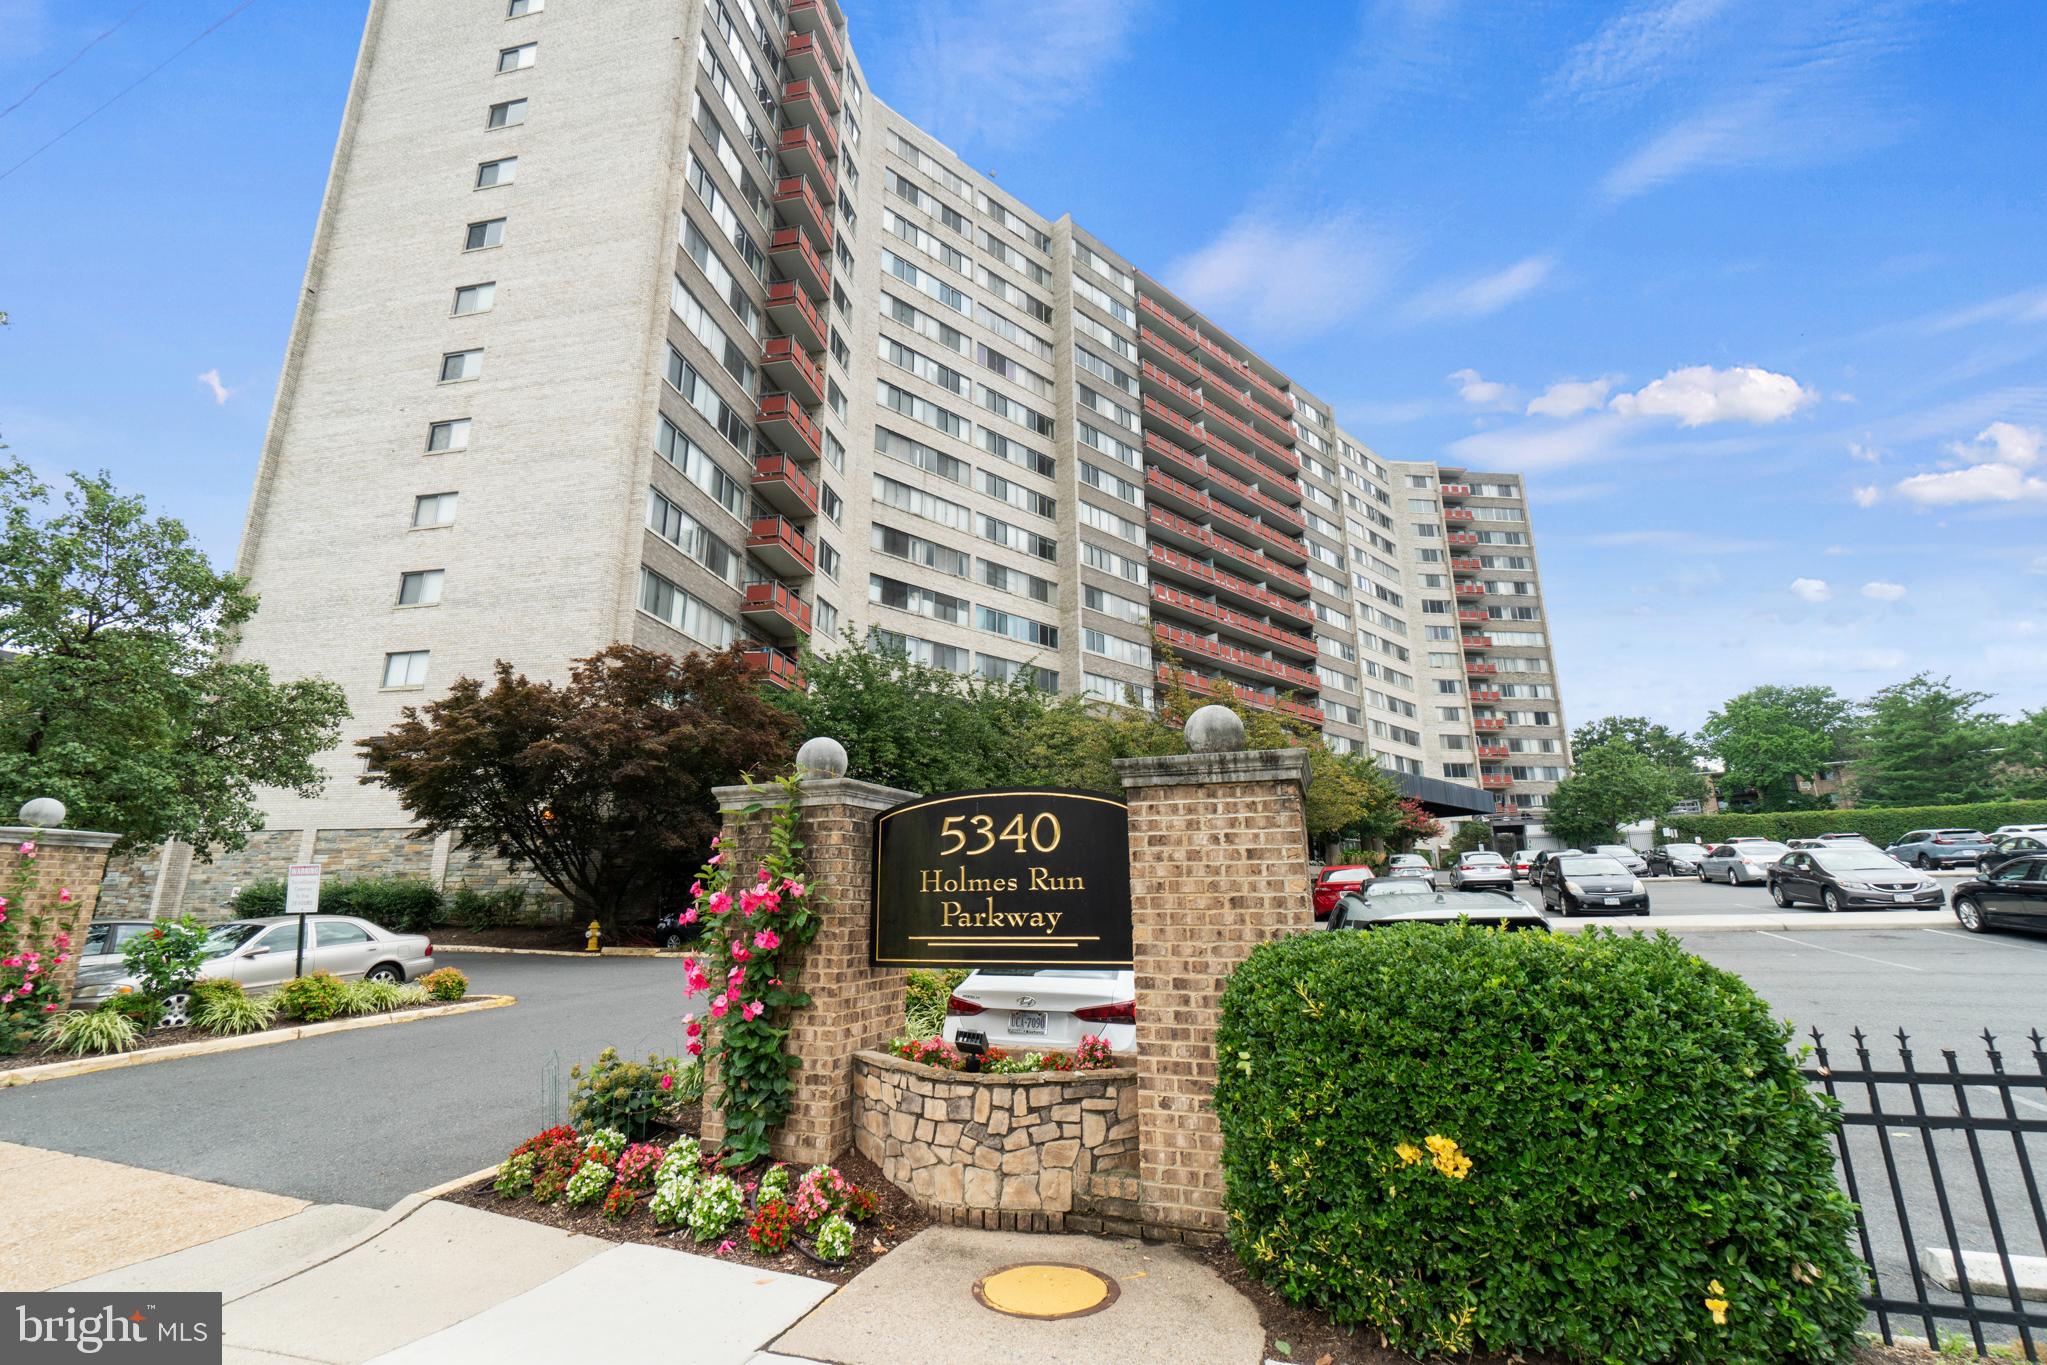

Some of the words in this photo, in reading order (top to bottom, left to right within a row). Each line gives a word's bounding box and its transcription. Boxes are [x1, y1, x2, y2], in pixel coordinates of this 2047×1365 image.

[940, 812, 1061, 856] 5340
[919, 865, 1018, 893] Holmes
[1028, 867, 1086, 892] Run
[940, 896, 1063, 934] Parkway
